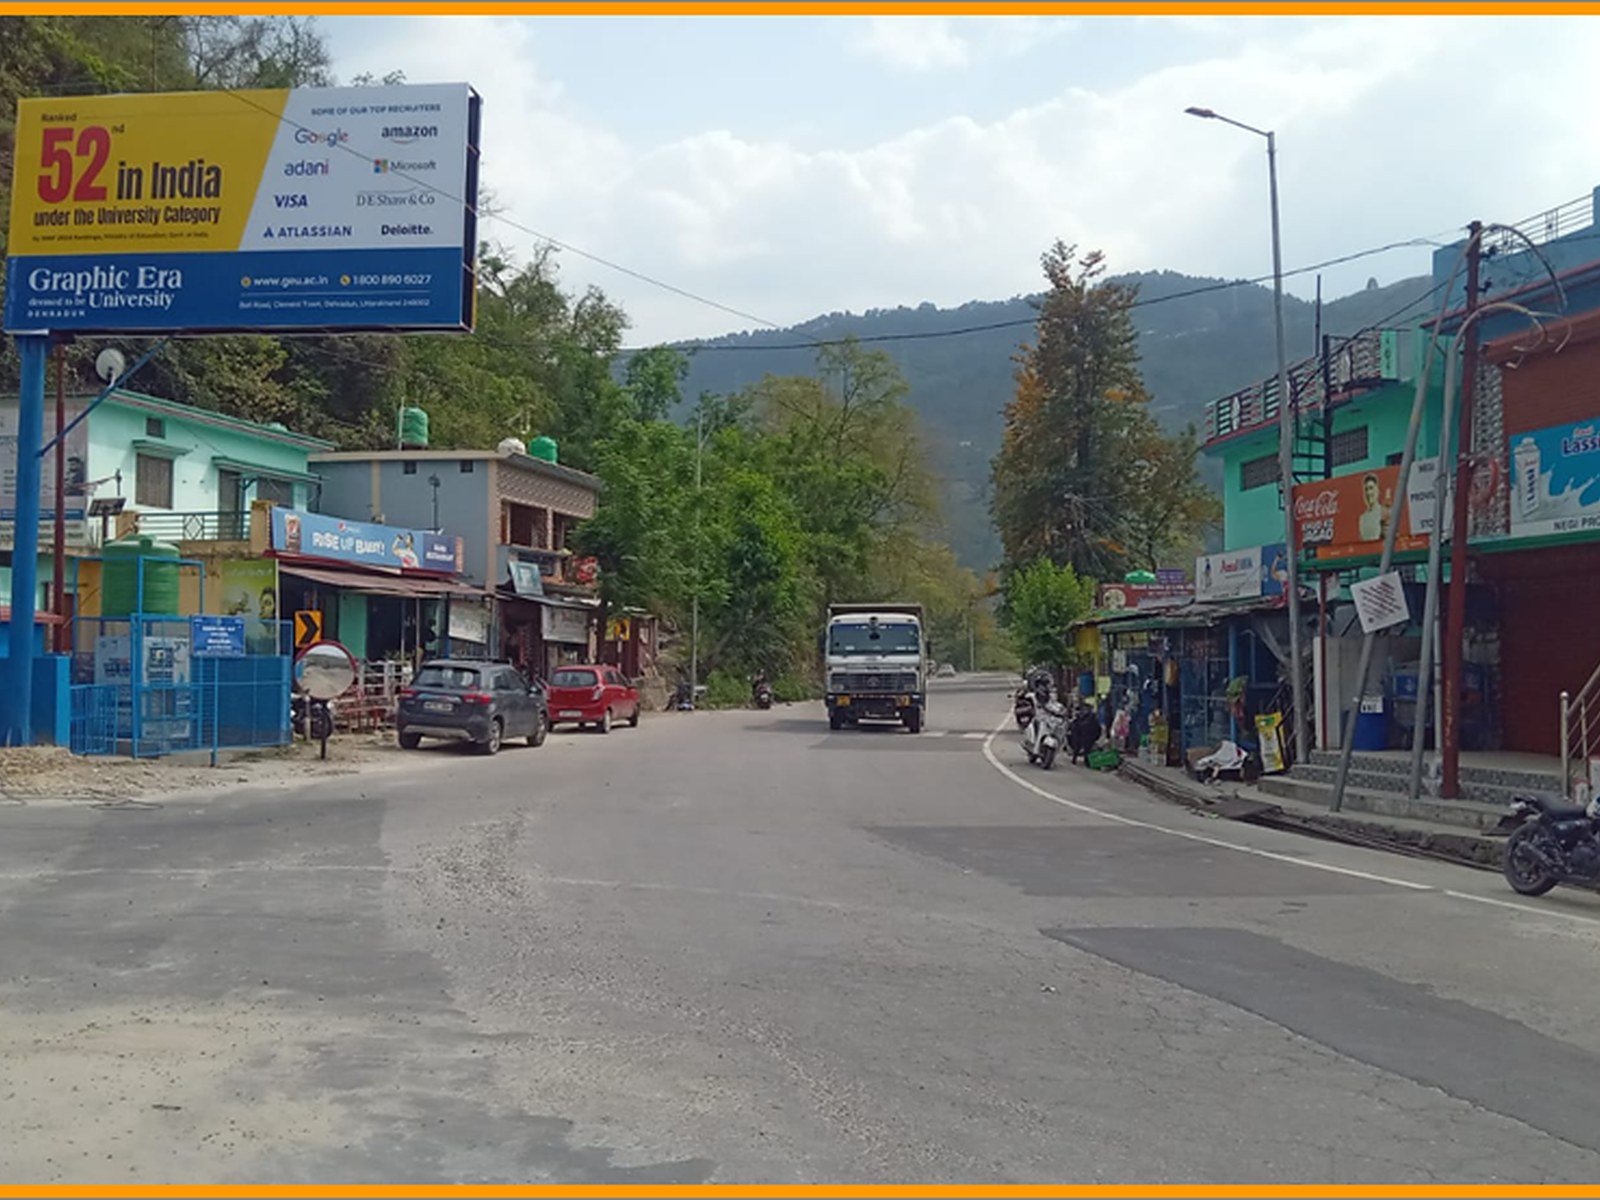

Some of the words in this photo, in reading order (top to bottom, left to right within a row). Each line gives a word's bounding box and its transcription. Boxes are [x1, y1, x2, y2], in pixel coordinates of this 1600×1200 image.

[337, 106, 347, 115] OF
[350, 106, 367, 114] OUR
[370, 105, 386, 113] TOP
[388, 103, 441, 113] RECRUITERS
[295, 127, 349, 147] Google
[381, 126, 438, 138] amazon
[284, 158, 329, 176] adani
[391, 160, 437, 170] Microsoft
[117, 161, 143, 200] in
[152, 159, 222, 199] India
[274, 194, 308, 208] VISA
[34, 209, 70, 226] under
[74, 208, 94, 226] the
[97, 206, 161, 226] University
[163, 205, 221, 226] Category
[278, 225, 352, 238] ATLASSIAN
[28, 264, 129, 296] Graphic
[136, 265, 182, 289] Era
[254, 275, 328, 288] www.geu.ac.in
[381, 274, 402, 285] 890
[403, 274, 432, 285] 6027
[88, 289, 175, 311] University
[1553, 518, 1578, 532] NEGI
[340, 537, 354, 551] UP
